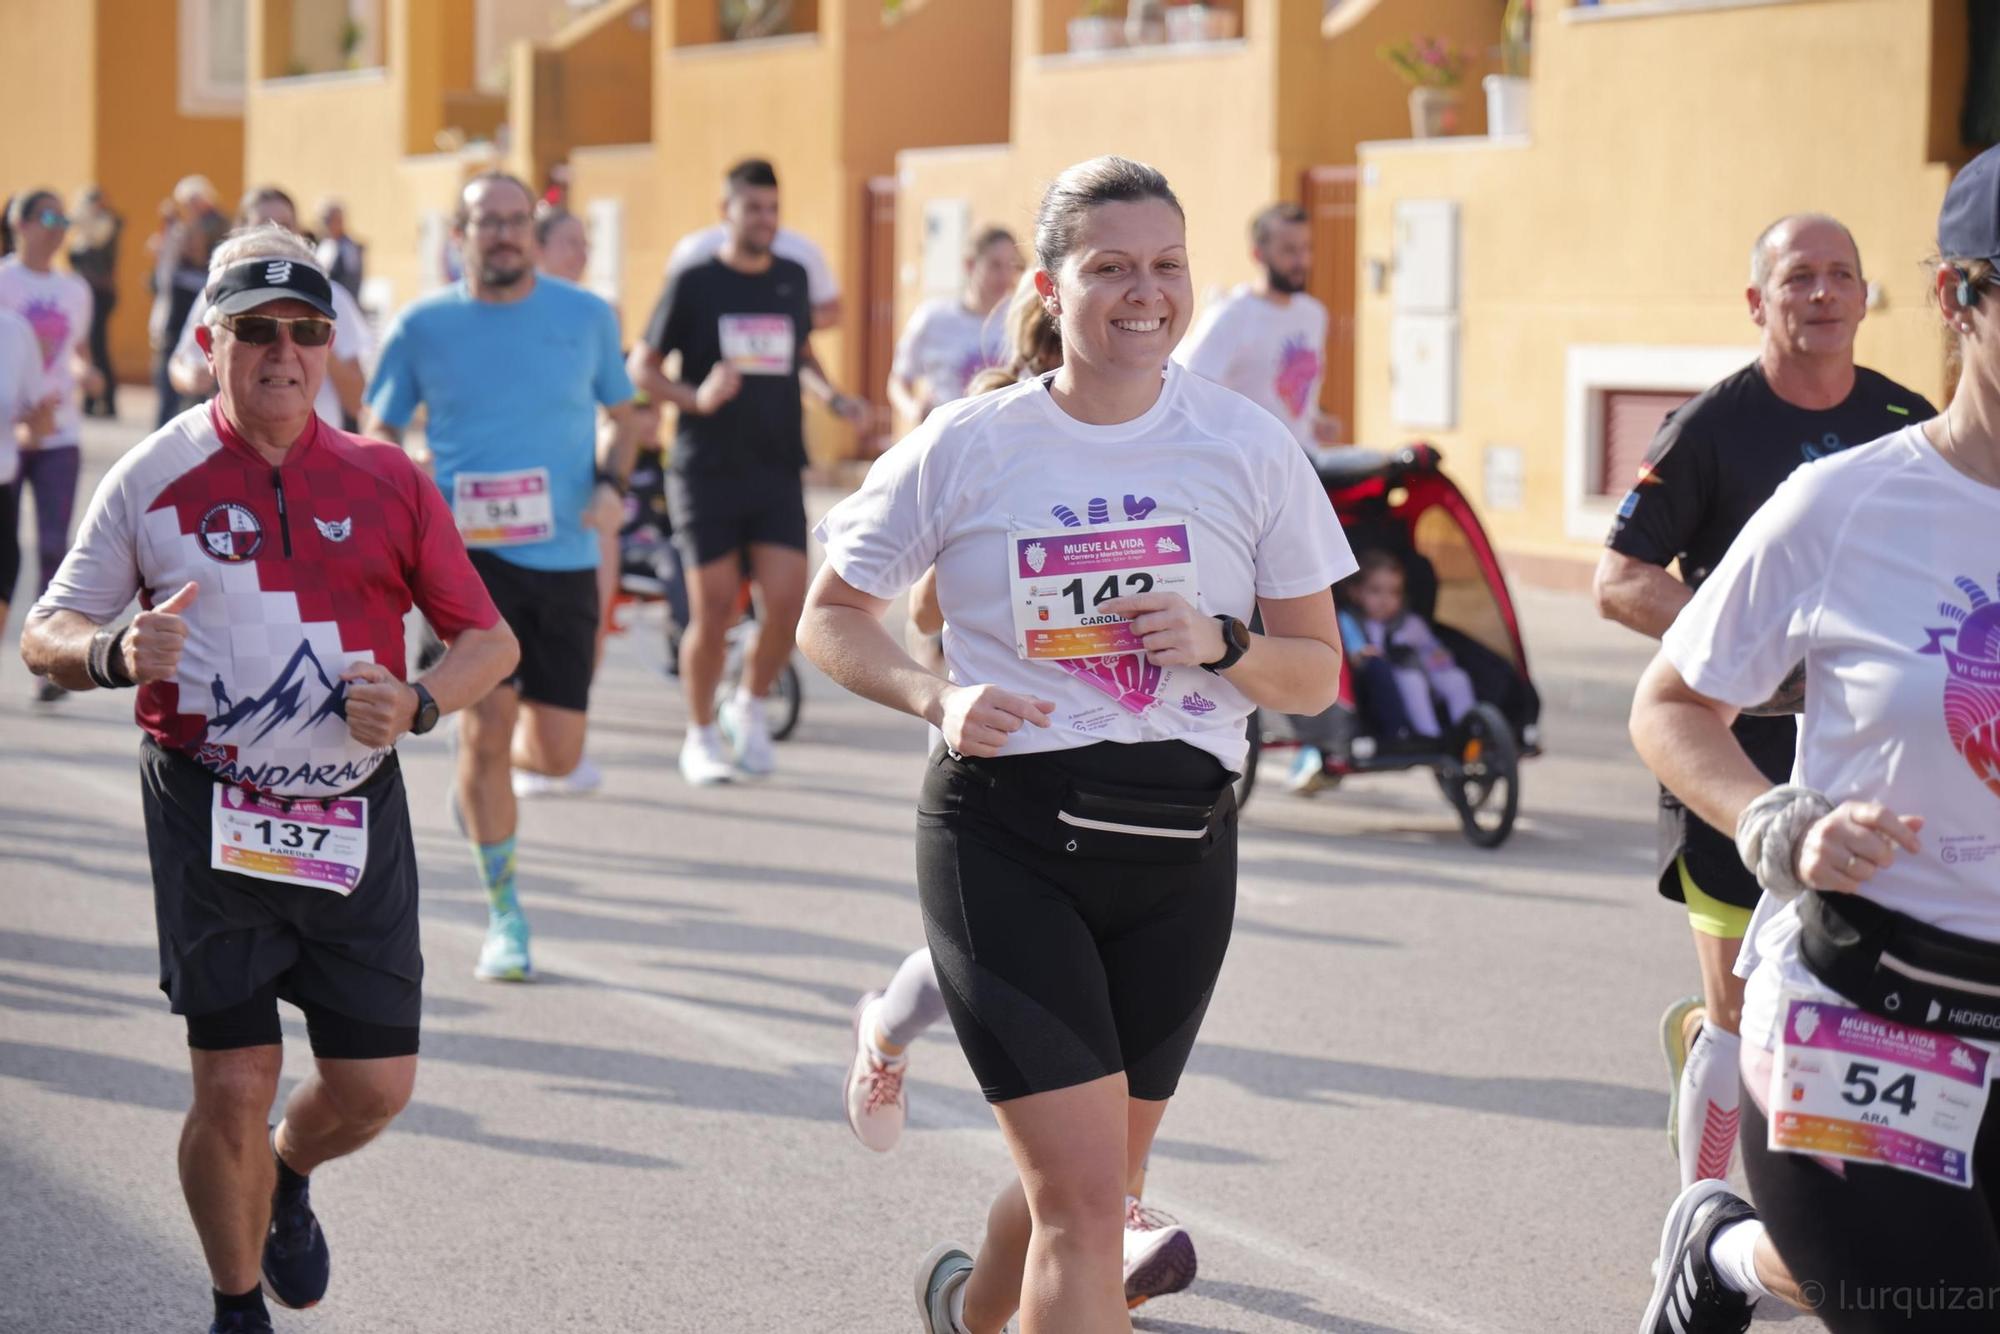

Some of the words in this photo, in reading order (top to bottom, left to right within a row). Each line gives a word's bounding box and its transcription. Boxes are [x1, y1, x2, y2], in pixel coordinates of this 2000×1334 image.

[1063, 542, 1102, 554] MUEVE
[1104, 540, 1118, 551] LA
[1119, 537, 1145, 549] VIDA
[1062, 572, 1154, 615] 142
[1956, 661, 1968, 675] VI
[254, 819, 331, 851] 137
[269, 847, 315, 859] PAREDES
[1840, 1017, 1886, 1037] MUEVE
[1888, 1029, 1905, 1041] LA
[1907, 1032, 1937, 1050] VIDA
[1841, 1061, 1917, 1117] 54
[1860, 1112, 1889, 1127] ARA
